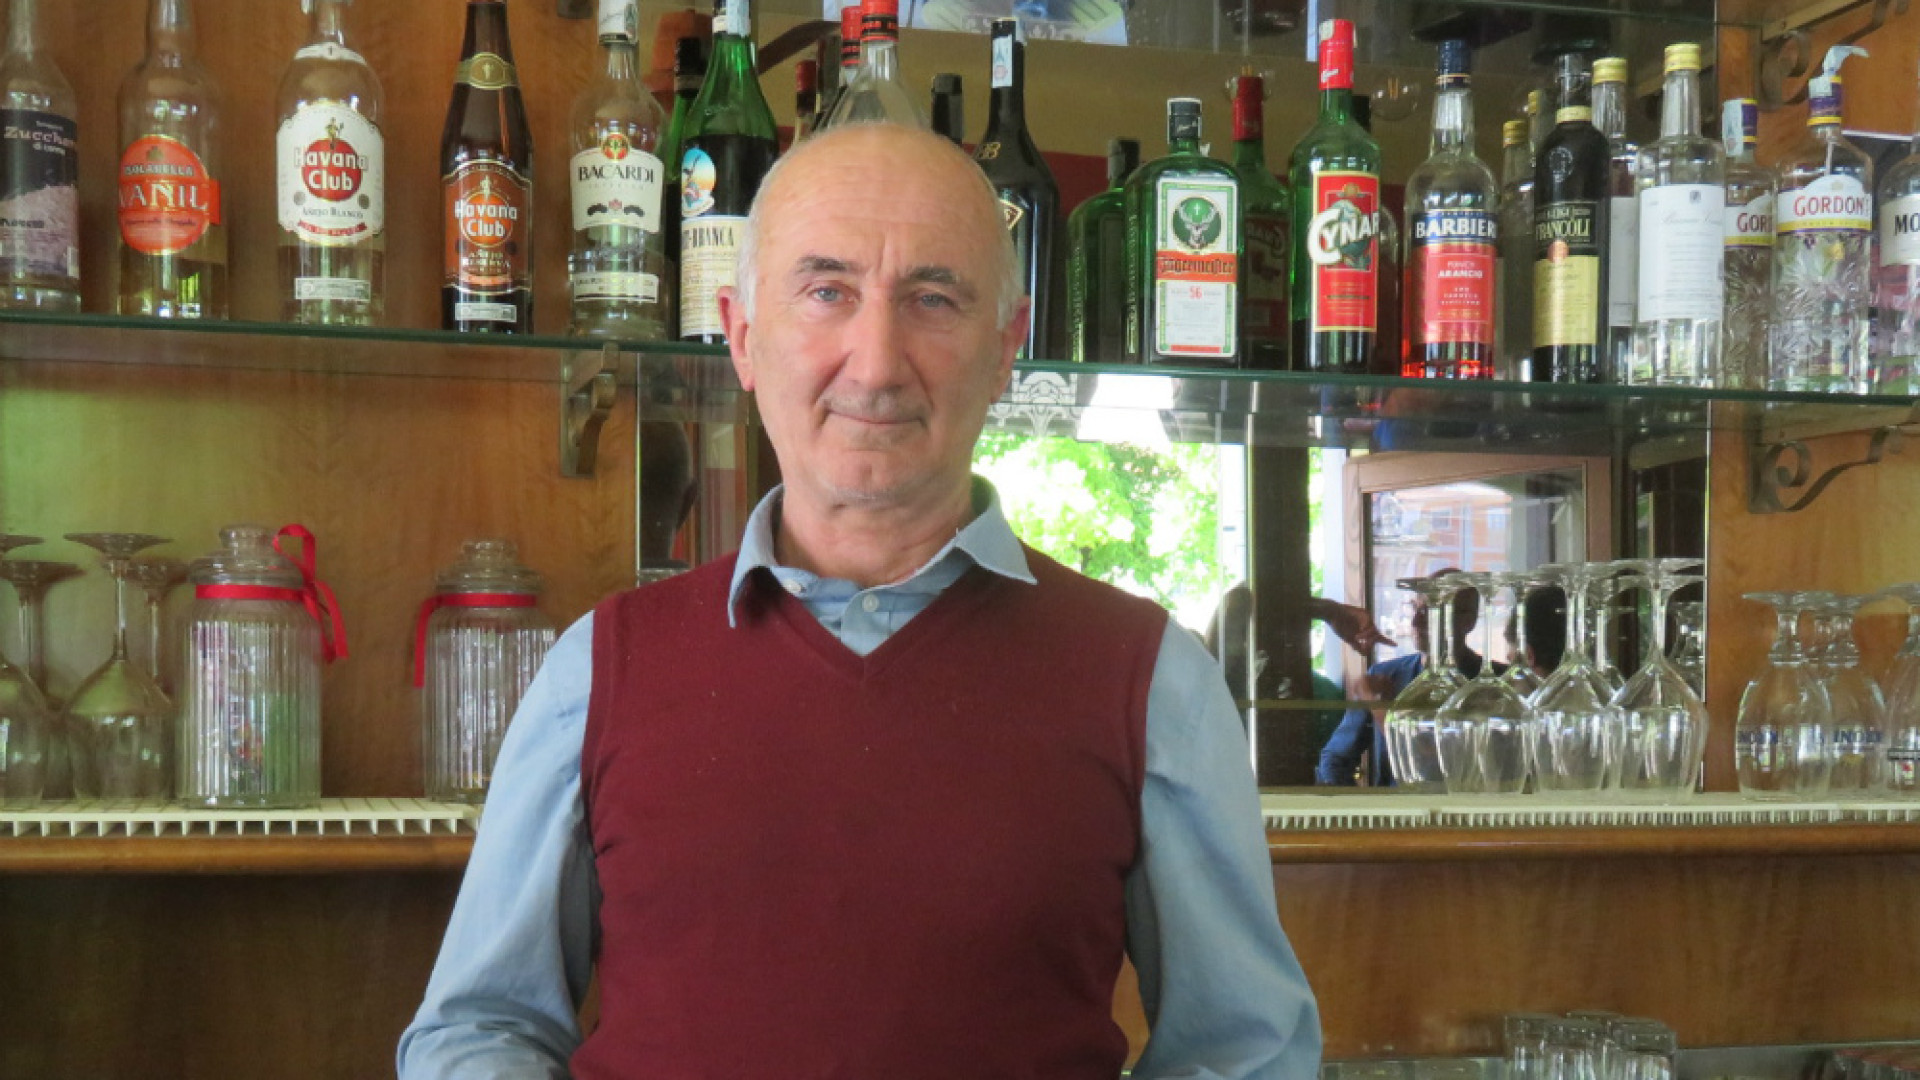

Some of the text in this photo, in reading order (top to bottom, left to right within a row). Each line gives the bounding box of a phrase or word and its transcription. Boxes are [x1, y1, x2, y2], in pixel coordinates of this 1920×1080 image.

[294, 147, 370, 172] Havana
[308, 168, 355, 191] Club
[577, 164, 655, 183] BACARDI
[454, 199, 518, 220] Havana
[466, 218, 506, 237] Club
